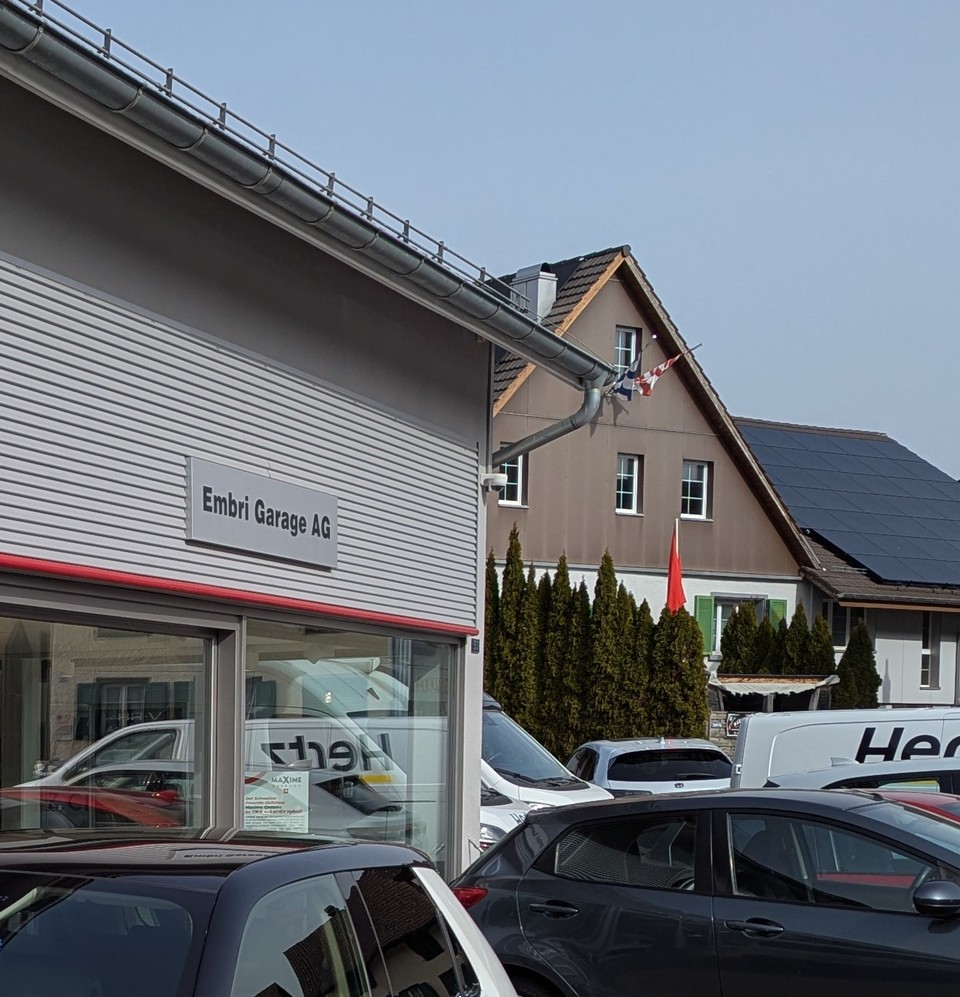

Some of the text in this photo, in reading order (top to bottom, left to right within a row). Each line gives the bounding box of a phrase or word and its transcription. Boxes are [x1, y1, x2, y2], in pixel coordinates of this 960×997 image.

[202, 485, 331, 540] Embri Garage AG
